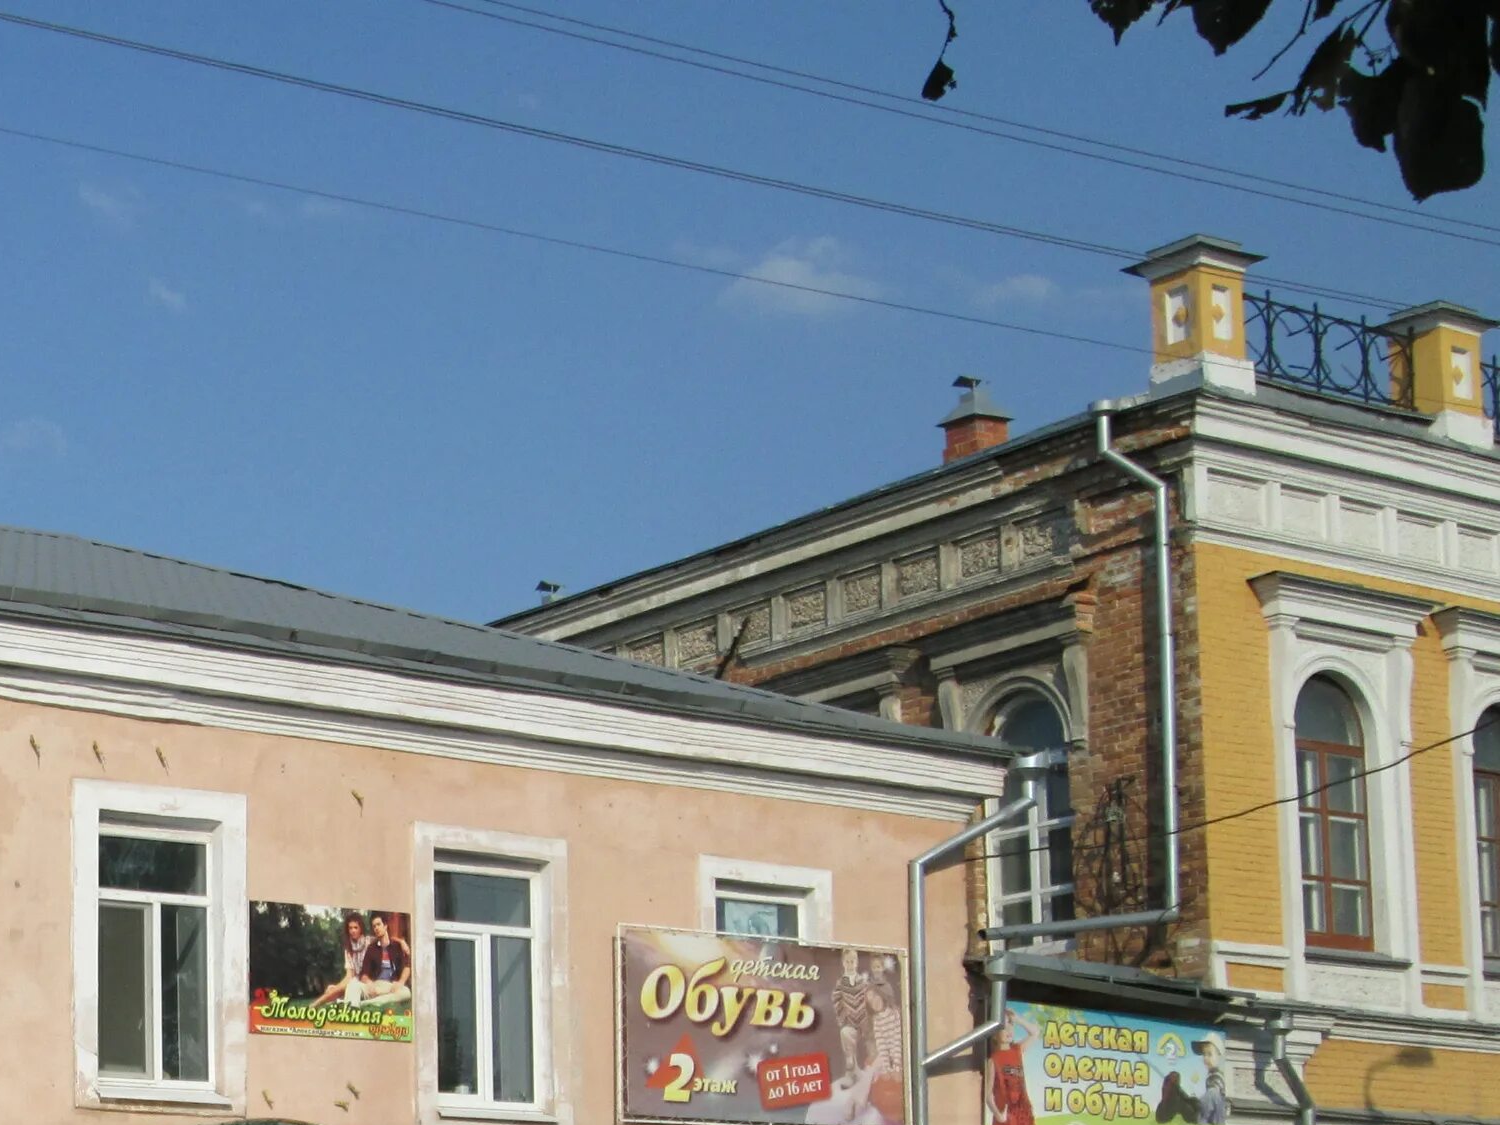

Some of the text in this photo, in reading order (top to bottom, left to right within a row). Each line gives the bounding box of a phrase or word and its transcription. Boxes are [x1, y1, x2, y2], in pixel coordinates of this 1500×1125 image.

[729, 956, 820, 982] детская
[254, 992, 383, 1029] Молодёжная
[640, 956, 816, 1037] Обувь
[663, 1053, 738, 1103] 2 этаж
[765, 1061, 821, 1083] от 1 года
[1043, 1053, 1150, 1088] одежда
[767, 1078, 823, 1100] до 16 лет
[1044, 1083, 1150, 1121] и обувь
